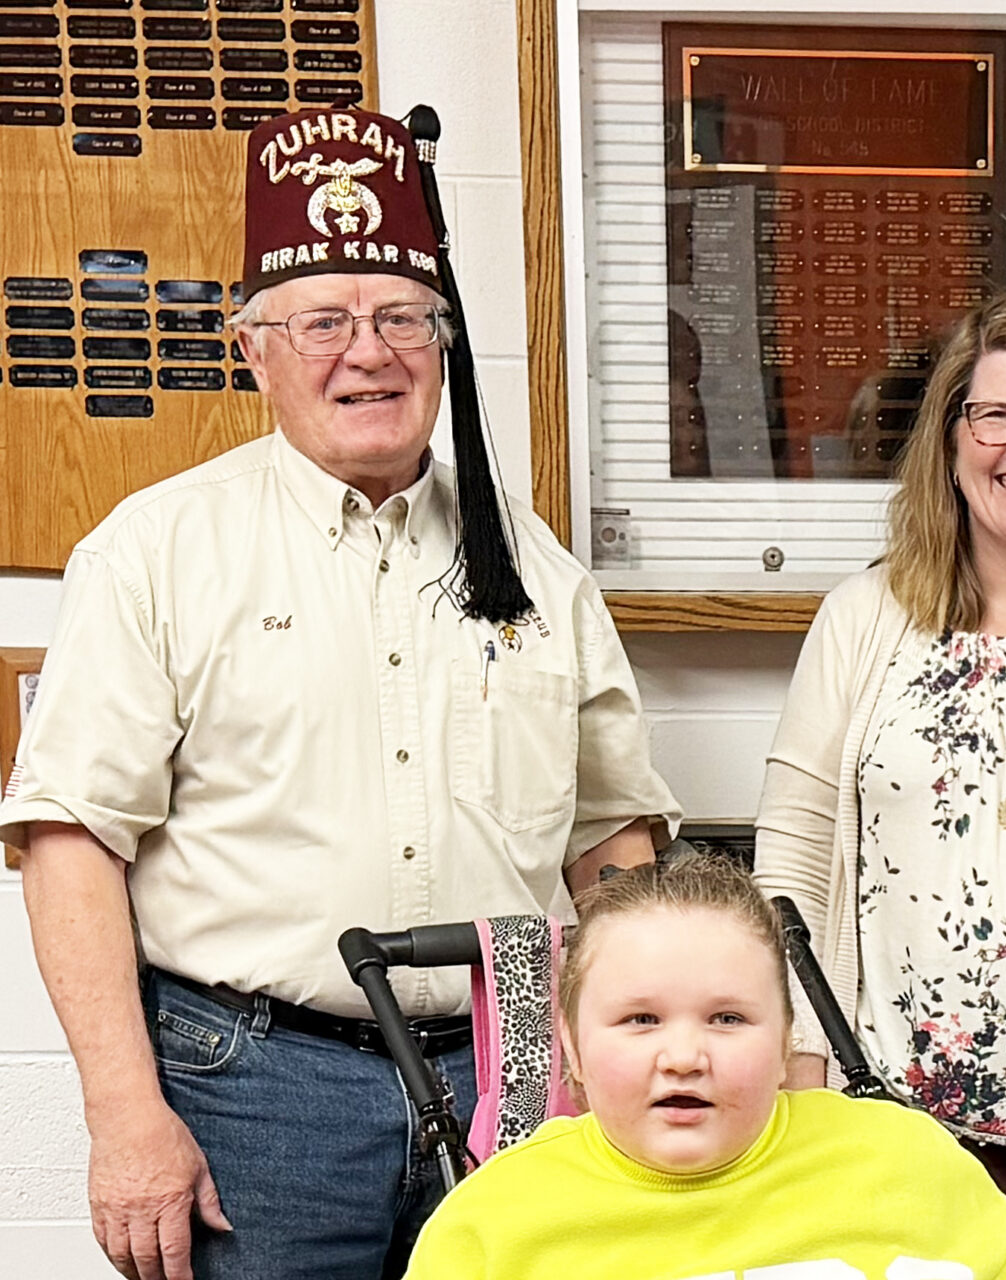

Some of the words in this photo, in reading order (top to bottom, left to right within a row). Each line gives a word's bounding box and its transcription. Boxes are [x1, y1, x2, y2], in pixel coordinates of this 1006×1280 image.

[260, 113, 405, 184] ZUHRAH
[261, 241, 329, 272] BIRAK
[344, 241, 399, 263] KAR
[262, 615, 292, 631] Bob
